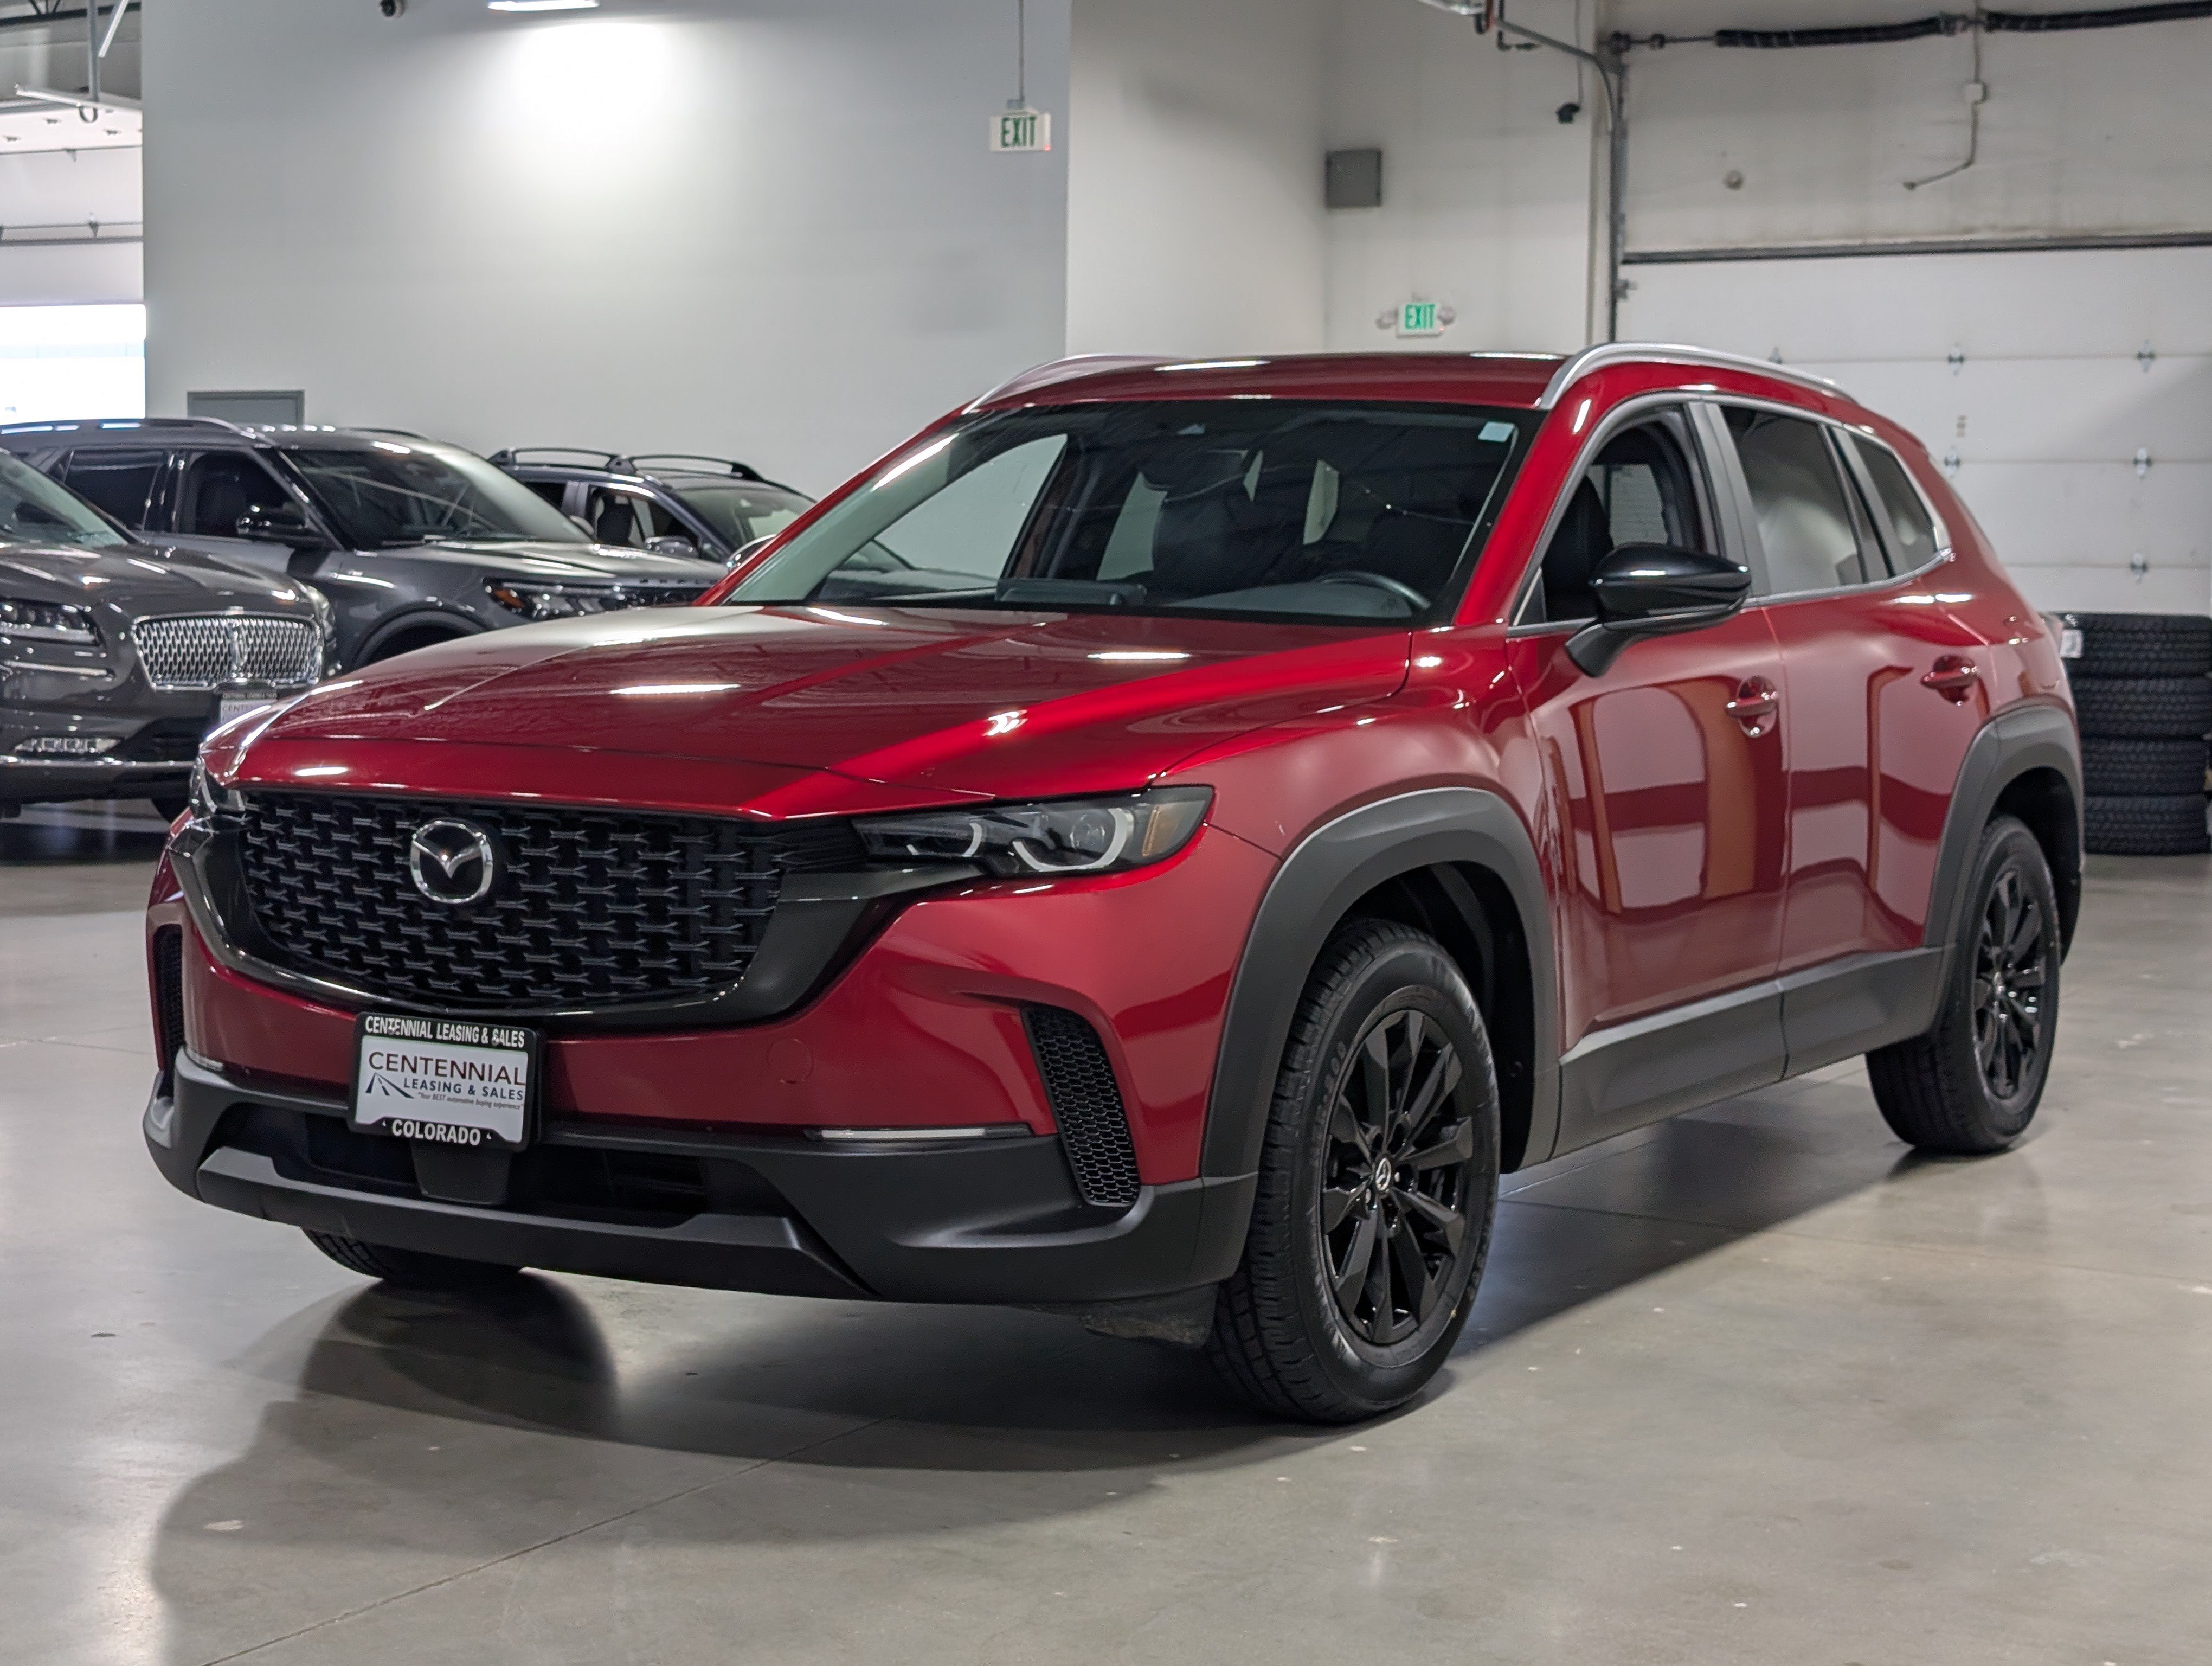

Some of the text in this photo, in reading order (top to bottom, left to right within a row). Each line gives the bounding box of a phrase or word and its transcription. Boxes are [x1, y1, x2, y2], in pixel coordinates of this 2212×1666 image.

[1001, 116, 1037, 147] EXIT
[1405, 304, 1435, 330] EXIT
[365, 1016, 525, 1048] CENTENNIAL LEASING & SALES
[369, 1052, 526, 1086] CENTENNIAL
[404, 1078, 523, 1100] LEASING & SALES
[475, 1098, 492, 1108] buying
[391, 1119, 481, 1145] COLORADO
